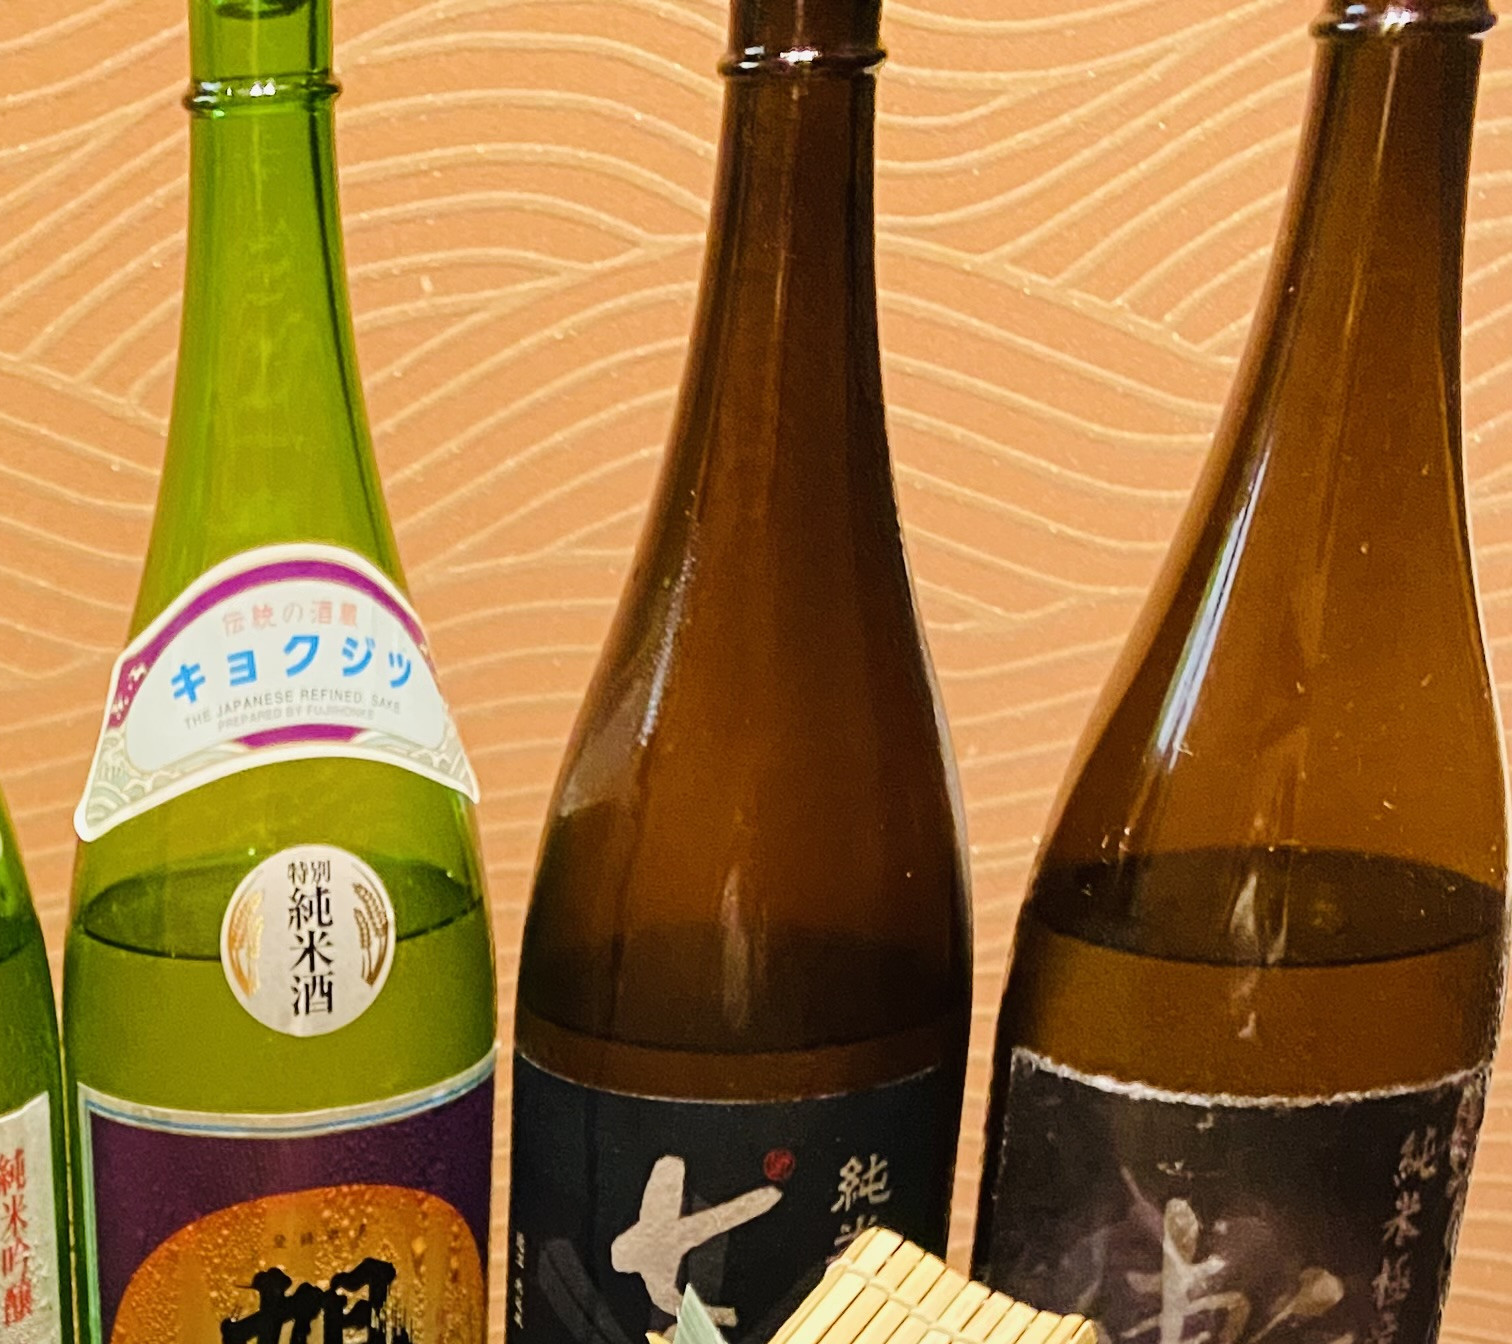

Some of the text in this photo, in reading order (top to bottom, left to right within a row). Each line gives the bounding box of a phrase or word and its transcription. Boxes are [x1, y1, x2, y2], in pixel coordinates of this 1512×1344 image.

[184, 709, 212, 731] THE
[216, 690, 293, 717] JAPANESE
[288, 859, 331, 885] 特別
[288, 885, 334, 1017] 純米酒
